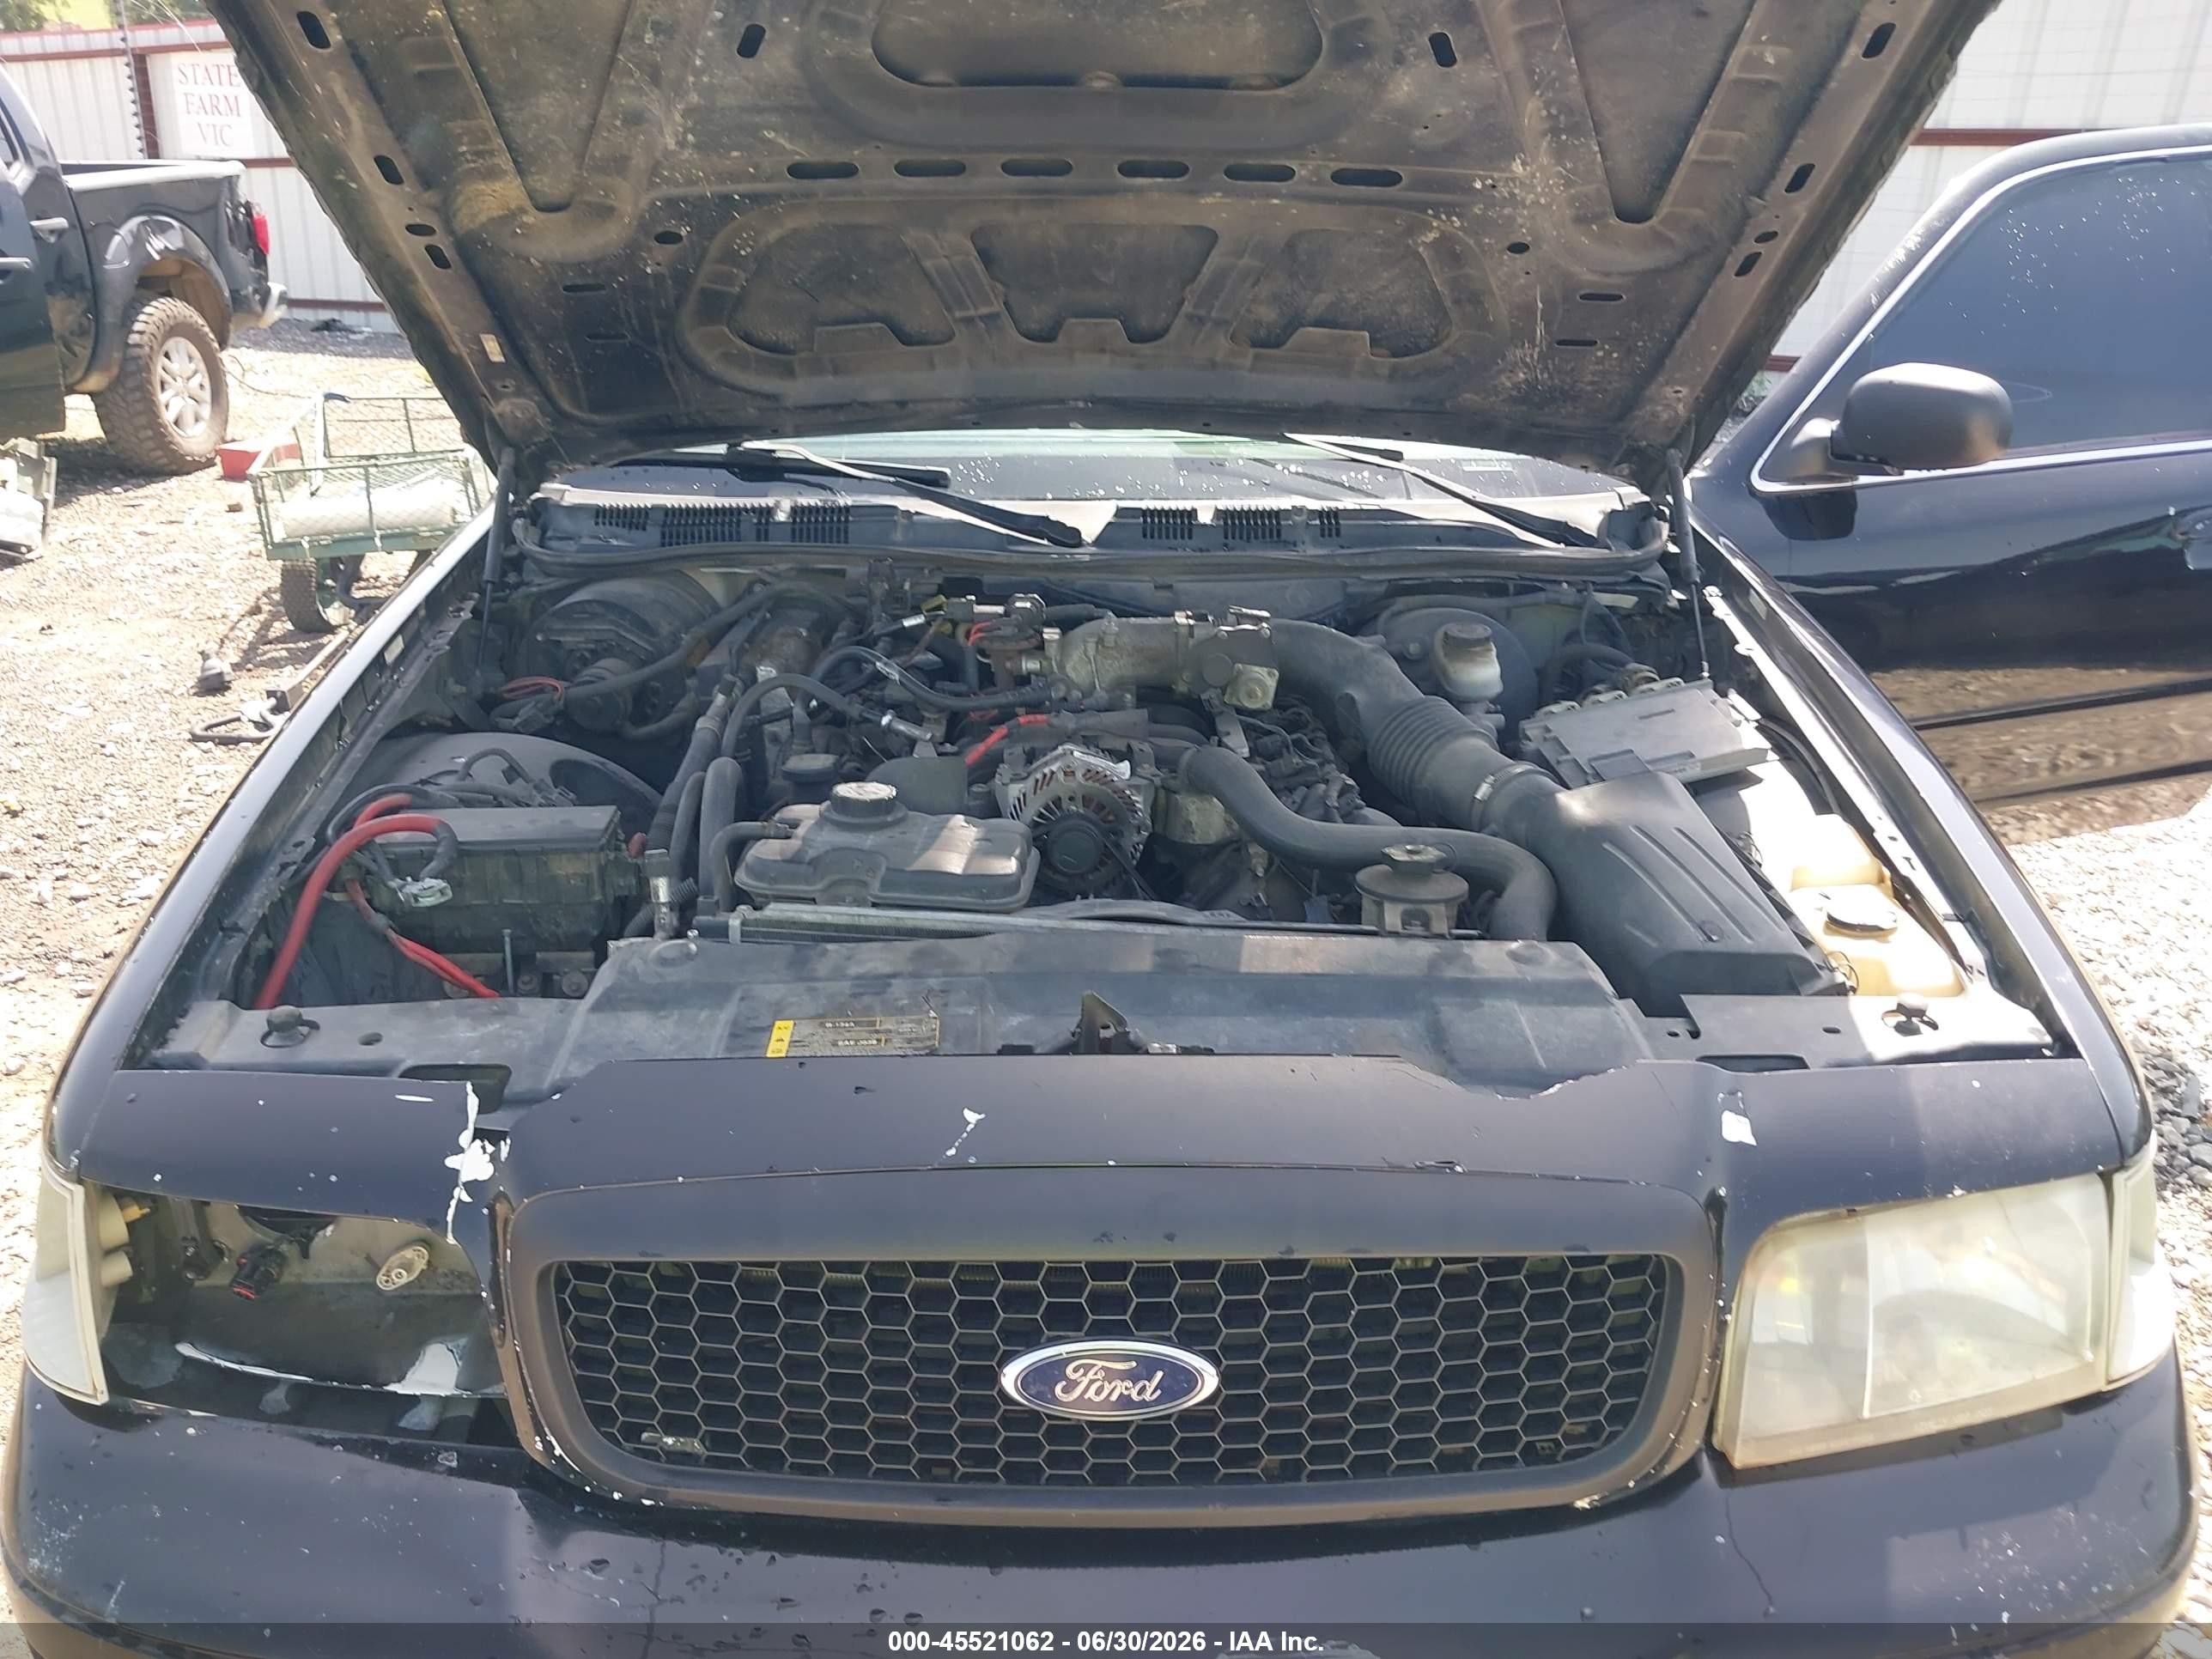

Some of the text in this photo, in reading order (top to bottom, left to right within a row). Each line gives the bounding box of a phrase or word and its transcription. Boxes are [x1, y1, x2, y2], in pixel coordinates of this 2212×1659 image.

[177, 63, 241, 88] STATE
[183, 92, 241, 118] FARM
[196, 121, 234, 148] VIC
[1054, 1358, 1164, 1403] Ford
